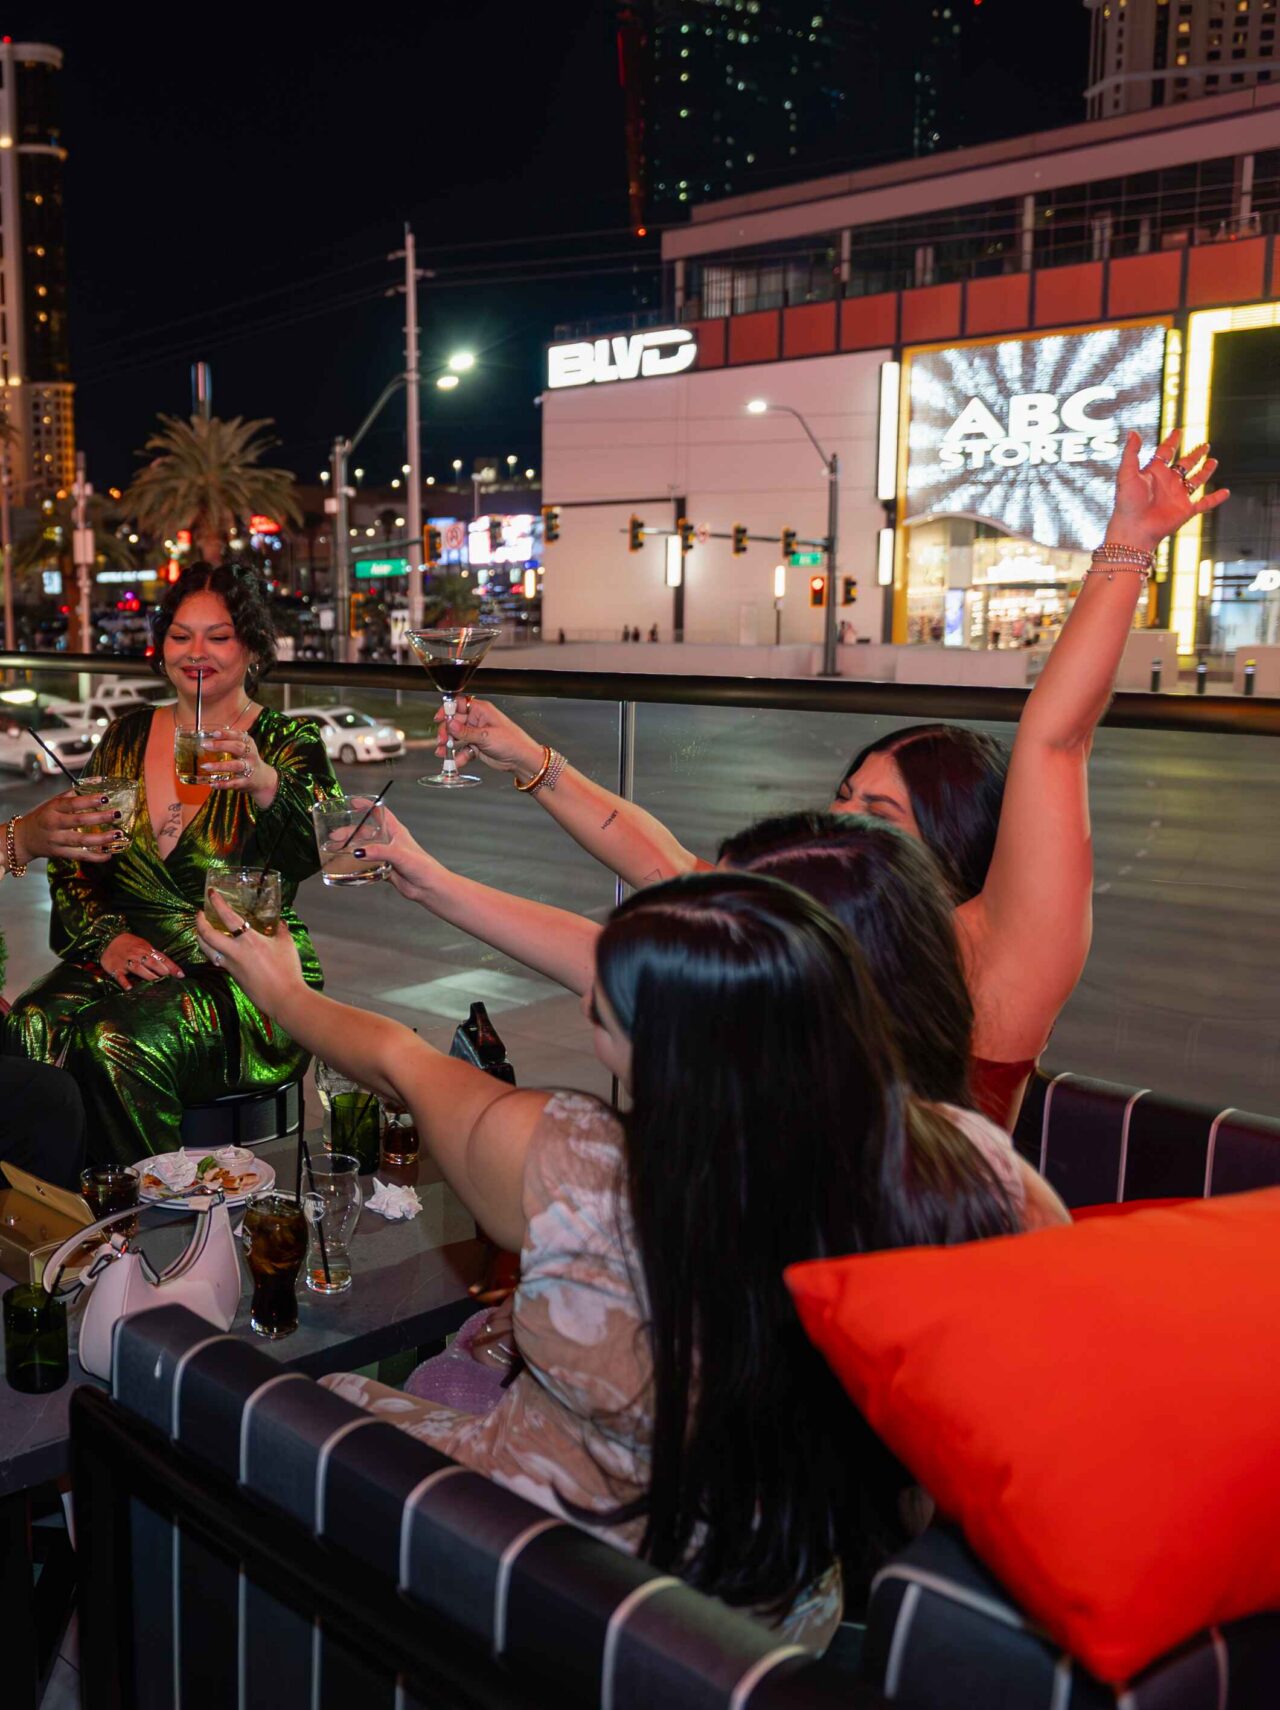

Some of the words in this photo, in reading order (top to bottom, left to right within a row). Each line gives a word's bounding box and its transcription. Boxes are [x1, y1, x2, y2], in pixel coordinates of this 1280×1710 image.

[548, 328, 698, 389] BLVD
[943, 386, 1117, 442] ABC
[938, 432, 1120, 470] STORES
